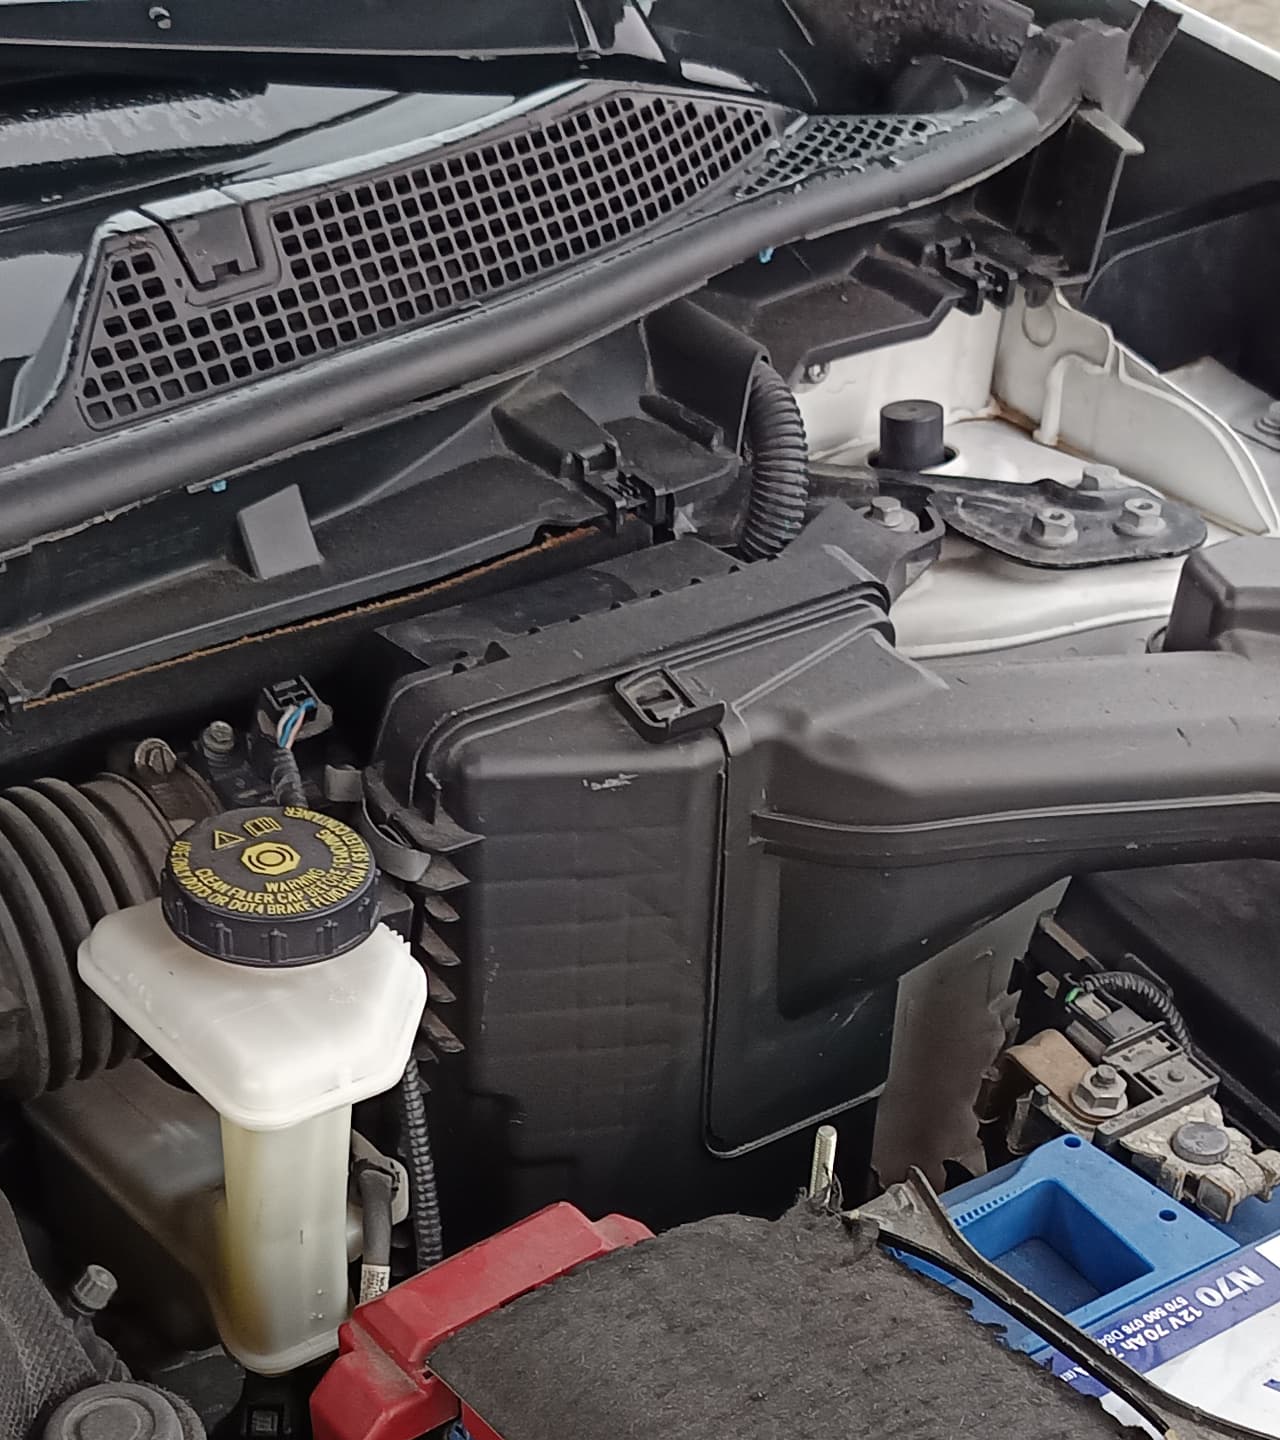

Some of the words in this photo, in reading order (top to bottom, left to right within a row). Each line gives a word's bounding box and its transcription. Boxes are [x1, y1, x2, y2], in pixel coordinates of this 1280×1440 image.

[284, 806, 351, 836] CONTAINER
[170, 840, 192, 857] USE
[315, 829, 350, 869] REMOVING
[342, 832, 370, 862] SEALED
[170, 857, 194, 877] ONLY
[195, 868, 231, 894] CLEAN
[265, 867, 326, 893] WARNING
[304, 868, 347, 898] BEFORE
[338, 870, 366, 893] FROM
[207, 893, 230, 906] OR
[227, 887, 274, 904] FILLER
[227, 899, 265, 914] DOT4
[277, 890, 304, 903] CAP
[310, 886, 348, 908] FLUID
[267, 900, 313, 915] BRAKE
[1194, 1261, 1265, 1309] N70
[1164, 1296, 1189, 1312] 570
[1142, 1307, 1168, 1324] 500
[1168, 1305, 1204, 1330] 12V
[1120, 1323, 1170, 1351] 70Ah
